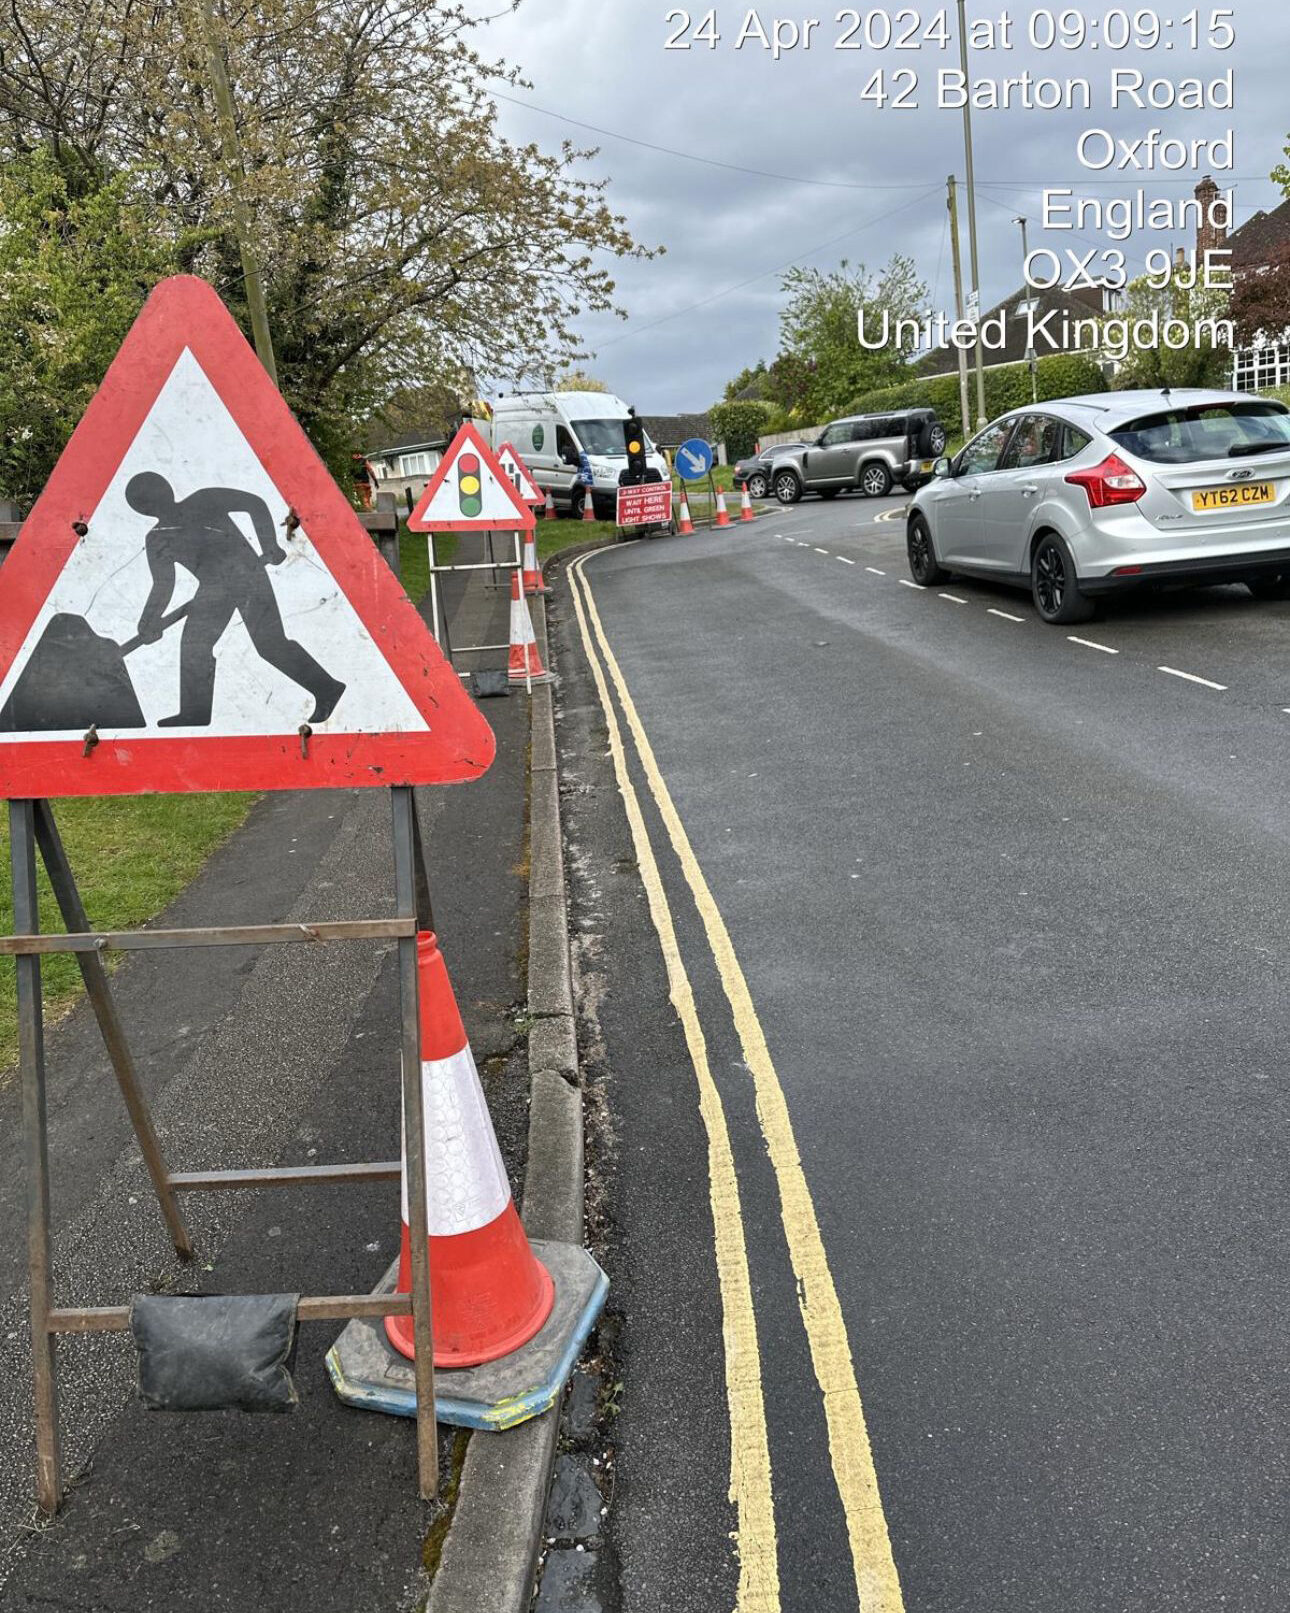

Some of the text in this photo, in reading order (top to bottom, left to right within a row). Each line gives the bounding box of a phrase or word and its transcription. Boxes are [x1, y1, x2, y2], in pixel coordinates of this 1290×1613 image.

[641, 485, 666, 493] CONTROL
[625, 495, 664, 507] WAIT HERE
[1200, 486, 1269, 506] YT62 CZM
[624, 505, 665, 515] UNTIL GREEN
[621, 513, 667, 524] LIGHT SHOWS
